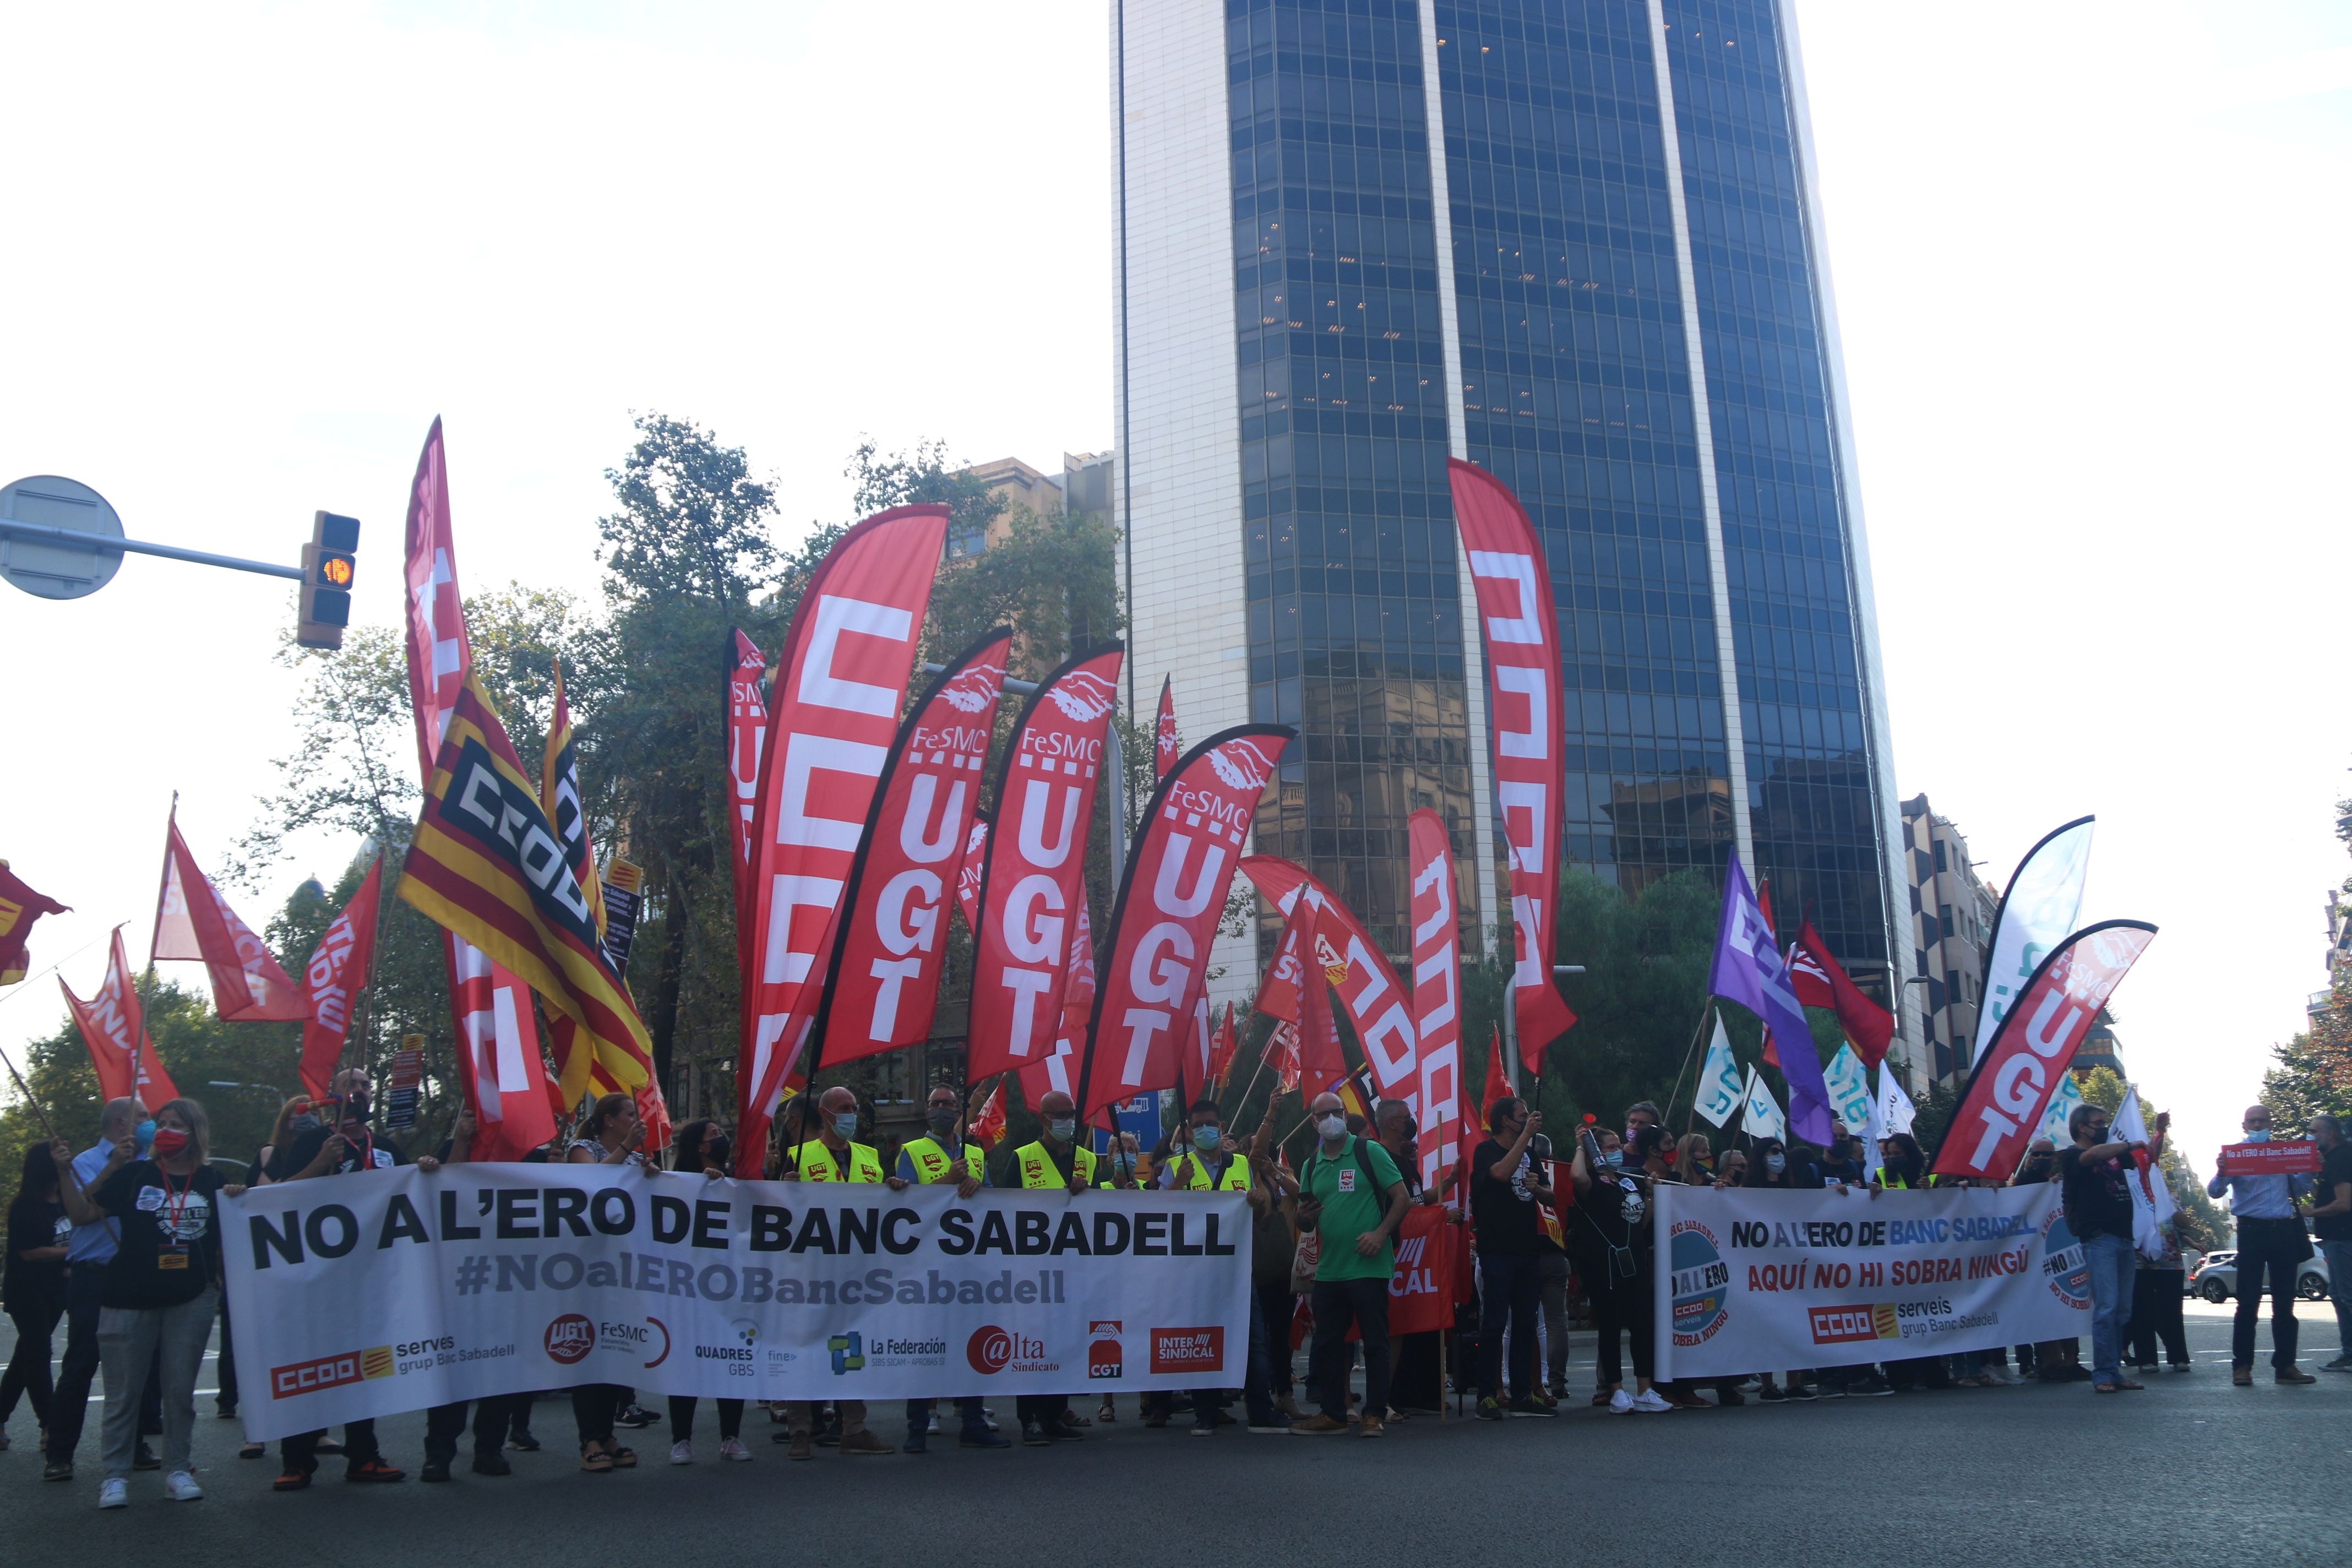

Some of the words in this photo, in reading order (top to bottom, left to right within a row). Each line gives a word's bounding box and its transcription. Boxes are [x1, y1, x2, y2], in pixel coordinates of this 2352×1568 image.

[912, 726, 987, 753] FeSMC
[1022, 727, 1101, 762] FeSMC
[1169, 781, 1248, 831] FeSMC
[869, 774, 966, 1043] UGT
[1001, 778, 1082, 1057] UGT
[1121, 831, 1226, 1087] UGT
[2056, 951, 2111, 1001] FeSMC
[1968, 988, 2083, 1172] UGT
[2226, 1150, 2235, 1158] No
[2259, 1148, 2265, 1156] al
[2267, 1147, 2282, 1156] Banc
[2283, 1145, 2311, 1155] Sabadell!
[811, 1163, 825, 1172] UGT
[248, 1204, 359, 1270] NO
[377, 1194, 429, 1249] A
[440, 1187, 635, 1240] L'ERO
[651, 1195, 730, 1249] DE
[749, 1205, 921, 1255] BANC
[938, 1208, 1235, 1256] SABADELL
[1685, 1219, 1718, 1250] SABADELL
[1732, 1221, 1769, 1248] NO
[1773, 1222, 1792, 1248] A
[1791, 1221, 1853, 1248] L'ERO
[1858, 1221, 1886, 1246] DE
[1891, 1218, 1948, 1245] BANC
[1953, 1213, 2038, 1242] SABADELL
[1749, 1257, 1808, 1293] AQUÍ
[1814, 1263, 1851, 1289] NO
[1859, 1261, 1883, 1288] HI
[1892, 1257, 1961, 1286] SOBRA
[1968, 1244, 2029, 1280] NINGÚ
[2043, 1253, 2067, 1277] #NO
[2066, 1249, 2076, 1267] A
[455, 1251, 1066, 1305] #NOalEROBancSabadell
[1388, 1268, 1439, 1297] CAL
[1680, 1272, 1692, 1294] A
[1675, 1303, 1703, 1316] CCOO
[1898, 1295, 1952, 1318] serveis
[552, 1320, 589, 1340] UGT
[601, 1322, 649, 1342] FeSMC
[1674, 1315, 1701, 1327] serveis
[1813, 1312, 1871, 1337] CCOO
[1902, 1319, 1928, 1338] grup
[1931, 1317, 1957, 1332] Banc
[1959, 1311, 1999, 1329] Sabadell
[396, 1335, 454, 1357] serves
[695, 1345, 753, 1361] QUADRES
[871, 1339, 884, 1354] La
[888, 1337, 946, 1355] Federación
[1159, 1337, 1194, 1348] INTER
[1159, 1347, 1215, 1359] SINDICAL
[399, 1355, 433, 1375] grup
[459, 1344, 515, 1362] Sabadell
[729, 1363, 754, 1376] GBS
[872, 1358, 885, 1367] SIBS
[886, 1358, 906, 1366] SICAM
[911, 1357, 938, 1366] APROBAS
[1011, 1362, 1060, 1373] Sindicato
[1091, 1364, 1120, 1376] CGT
[279, 1359, 356, 1392] CCOO
